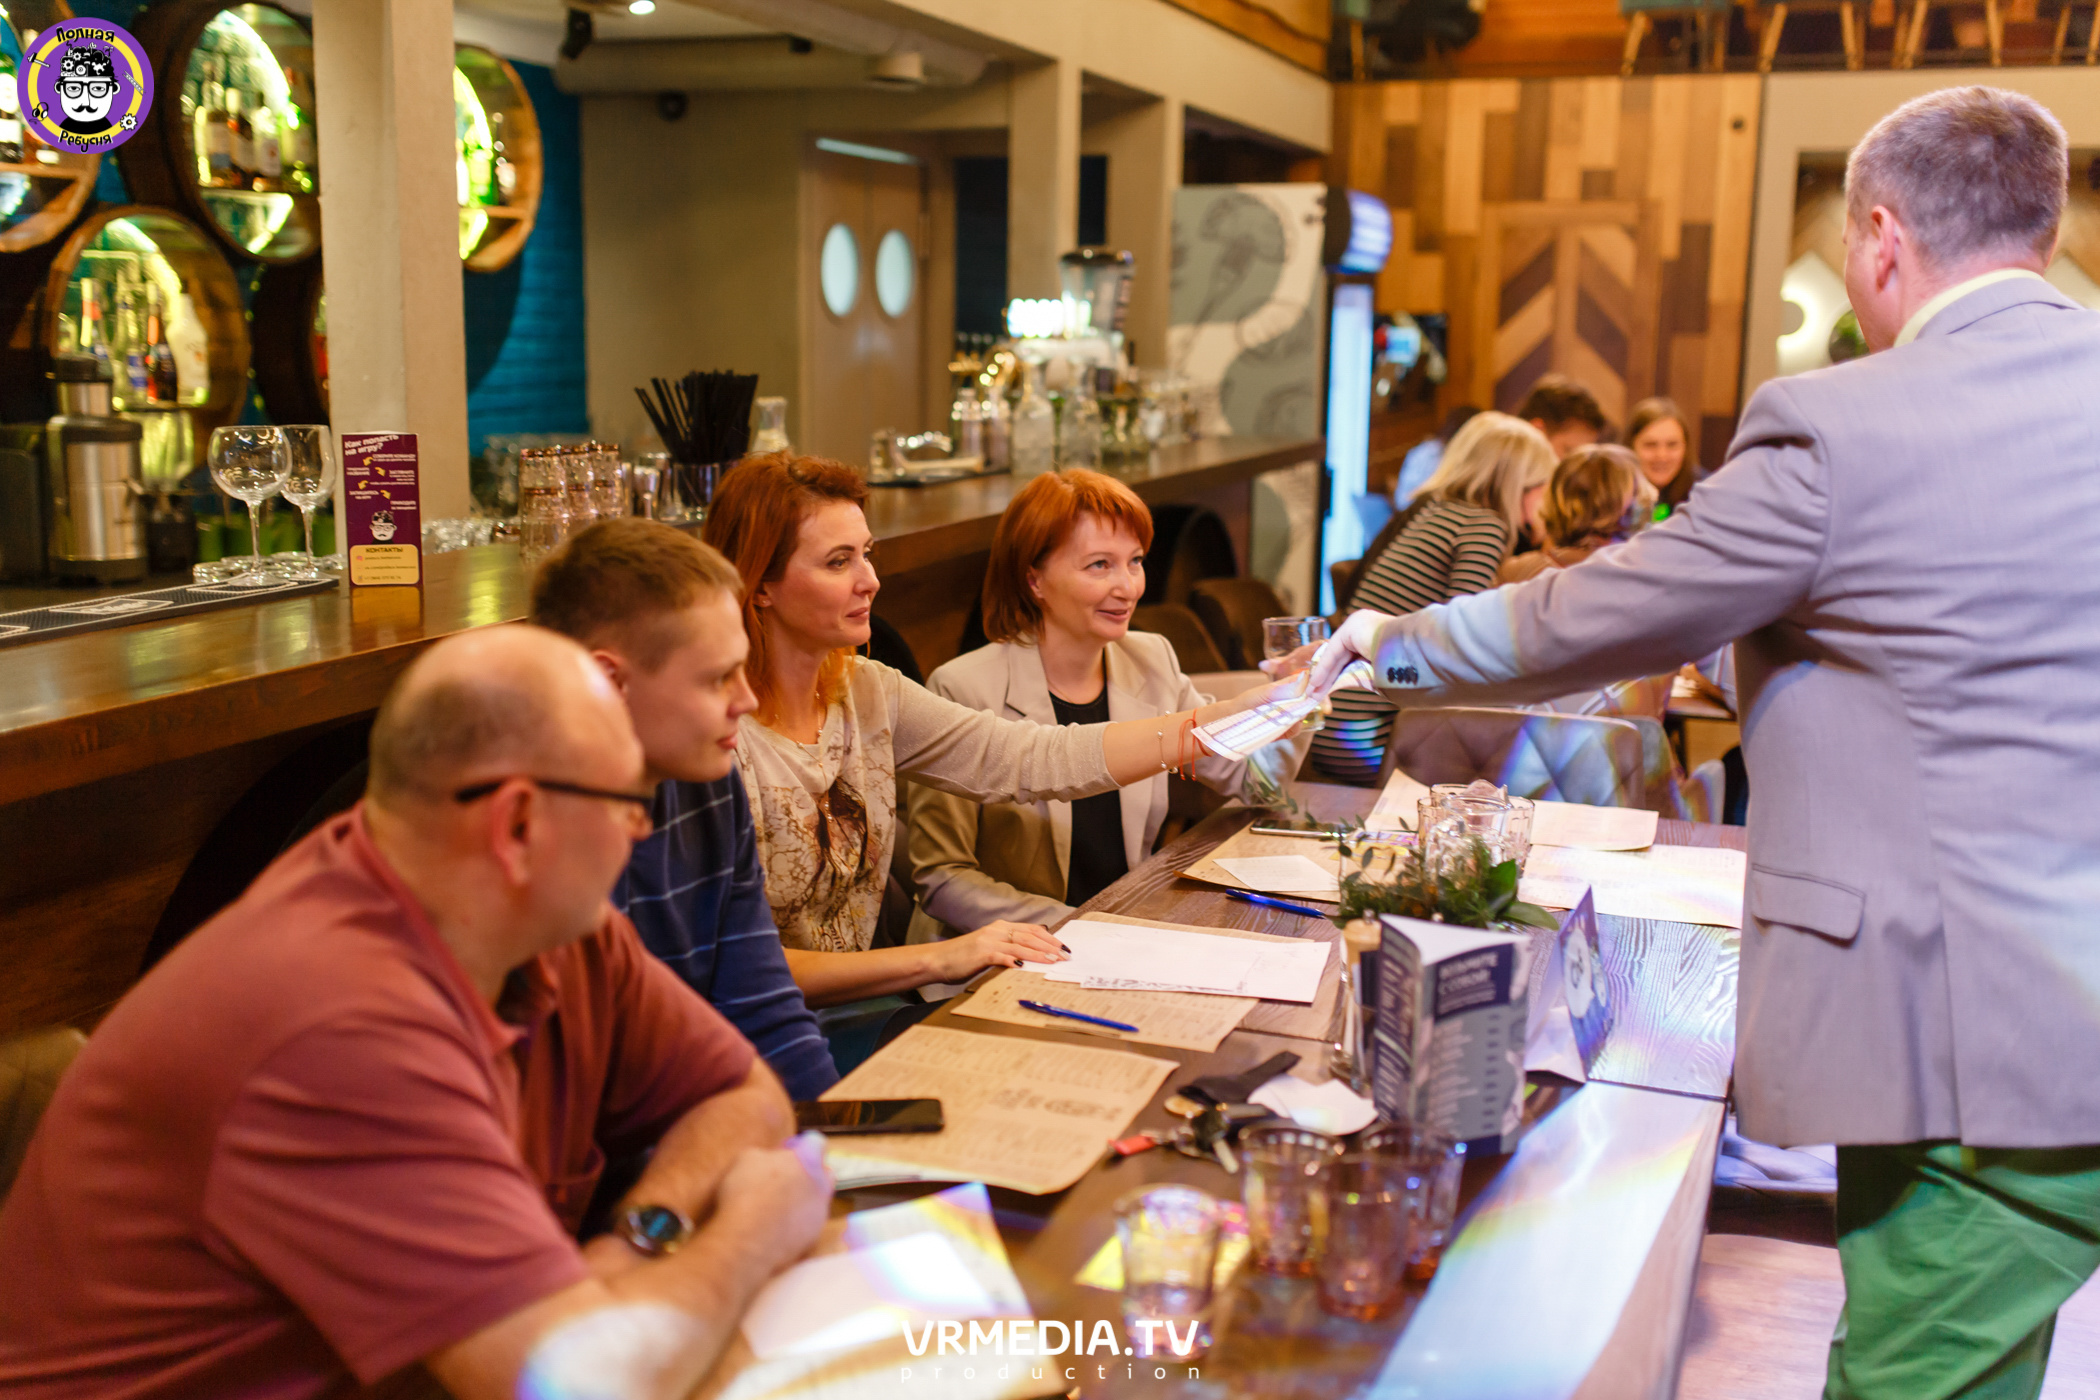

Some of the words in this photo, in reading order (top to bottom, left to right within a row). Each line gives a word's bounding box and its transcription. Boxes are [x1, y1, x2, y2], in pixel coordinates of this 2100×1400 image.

[344, 440, 361, 448] Как
[363, 435, 399, 445] попасть
[358, 442, 384, 453] игру?
